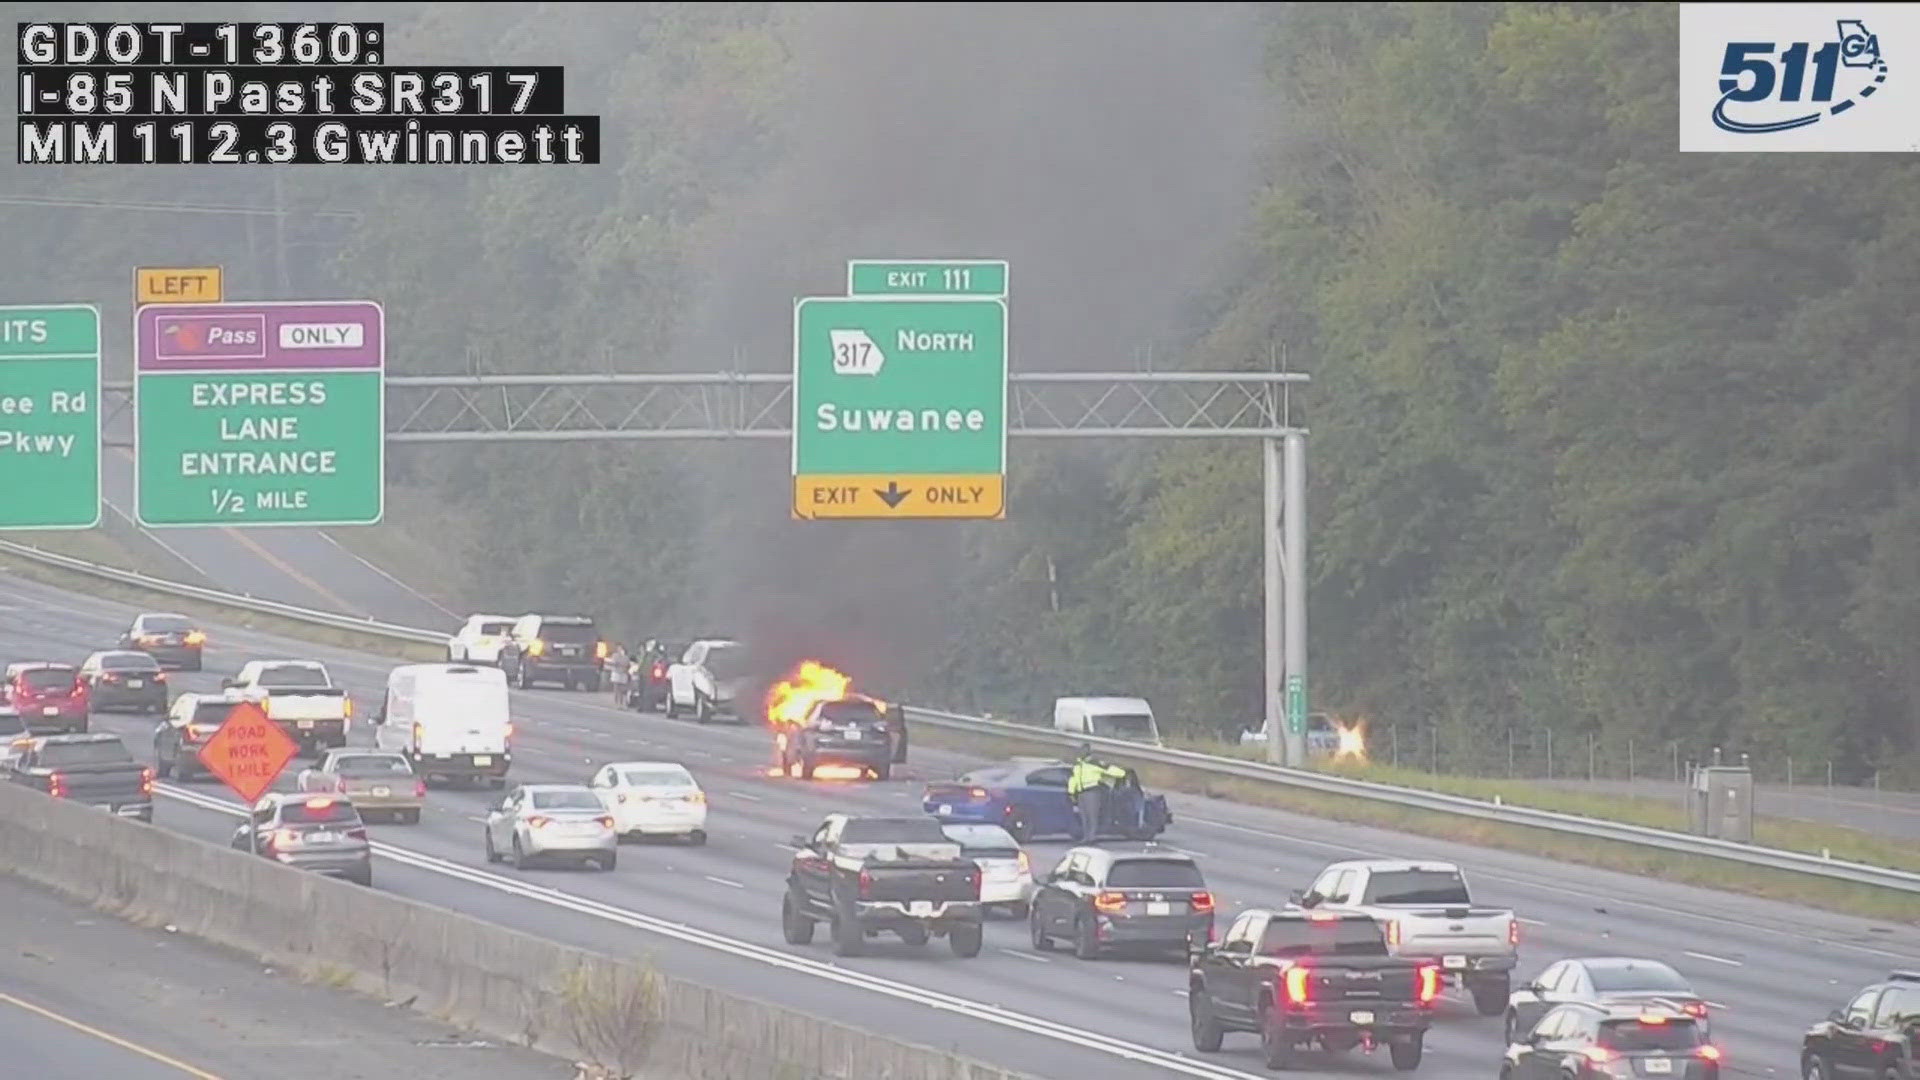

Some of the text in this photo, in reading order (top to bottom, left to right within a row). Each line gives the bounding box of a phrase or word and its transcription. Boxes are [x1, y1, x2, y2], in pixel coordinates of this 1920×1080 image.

[149, 276, 208, 296] LEFT
[887, 269, 971, 290] EXIT 111
[4, 320, 48, 343] ITS
[208, 327, 351, 346] Pass ONLY
[837, 343, 872, 367] 317
[1, 390, 87, 414] ee Rd
[192, 382, 327, 407] EXPRESS
[817, 403, 985, 431] Suwanee
[221, 417, 298, 441] LANE
[182, 451, 337, 476] ENTRANCE
[256, 491, 309, 510] MILE
[813, 487, 985, 504] EXIT ONLY
[227, 725, 267, 740] ROAD
[228, 743, 270, 759] WORK
[237, 761, 271, 777] MILE
